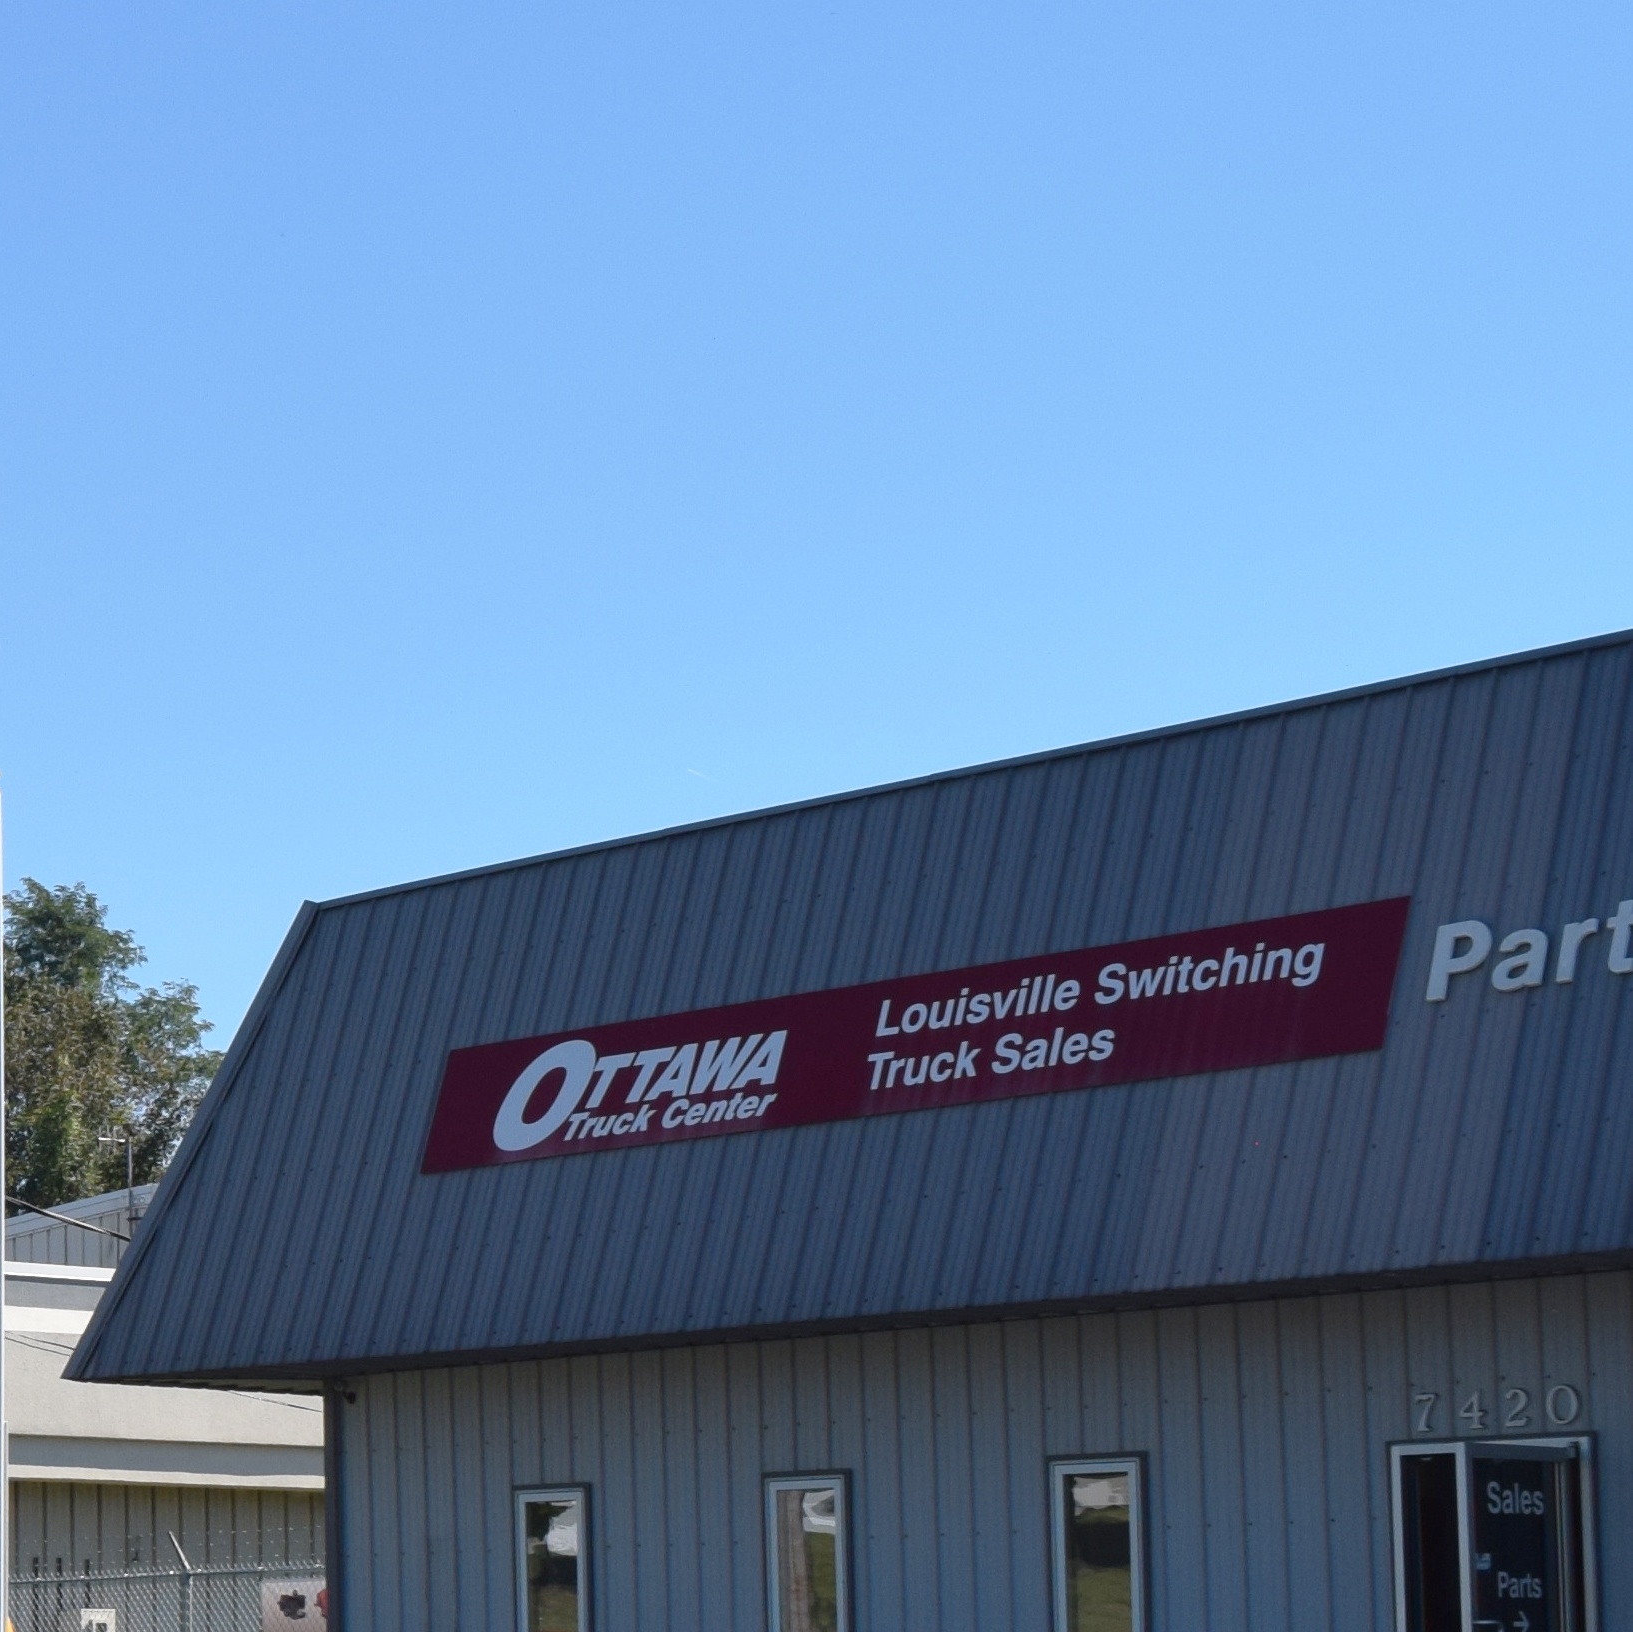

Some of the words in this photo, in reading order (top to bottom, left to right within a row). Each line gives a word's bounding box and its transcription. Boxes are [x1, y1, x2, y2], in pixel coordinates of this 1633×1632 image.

[875, 975, 1081, 1037] Louisville
[1094, 942, 1325, 1004] Switching
[867, 1041, 980, 1090] Truck
[991, 1027, 1116, 1074] Sales
[493, 1029, 788, 1151] OTTAWA
[563, 1103, 656, 1141] Truck
[661, 1092, 778, 1129] Center
[1414, 1384, 1580, 1433] 7420
[1487, 1481, 1544, 1515] Sales
[1497, 1571, 1542, 1598] Parts
